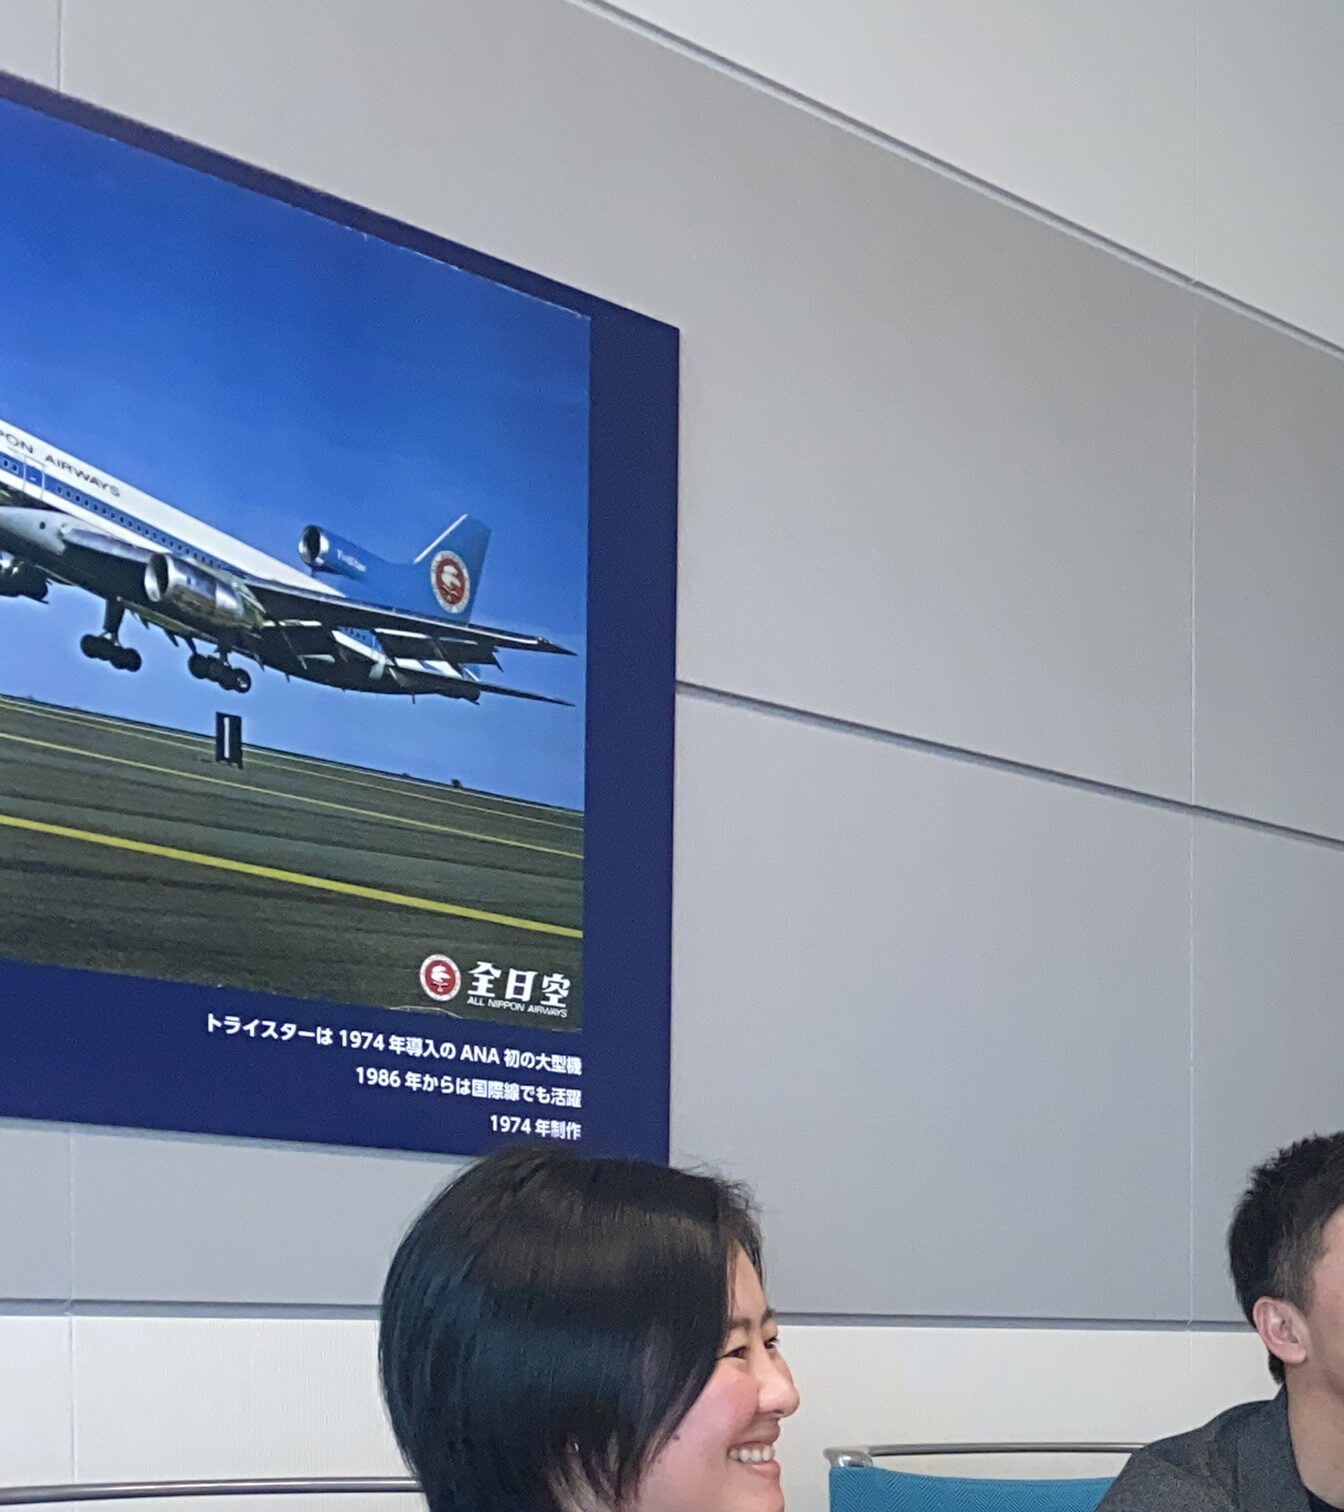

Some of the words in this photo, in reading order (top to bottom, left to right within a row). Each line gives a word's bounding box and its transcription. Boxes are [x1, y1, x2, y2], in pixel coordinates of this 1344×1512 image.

[45, 454, 121, 498] AIRWAYS
[467, 961, 571, 1008] 全日空
[466, 996, 486, 1007] ALL
[487, 999, 526, 1012] NIPPON
[527, 1004, 568, 1019] AIRWAYS
